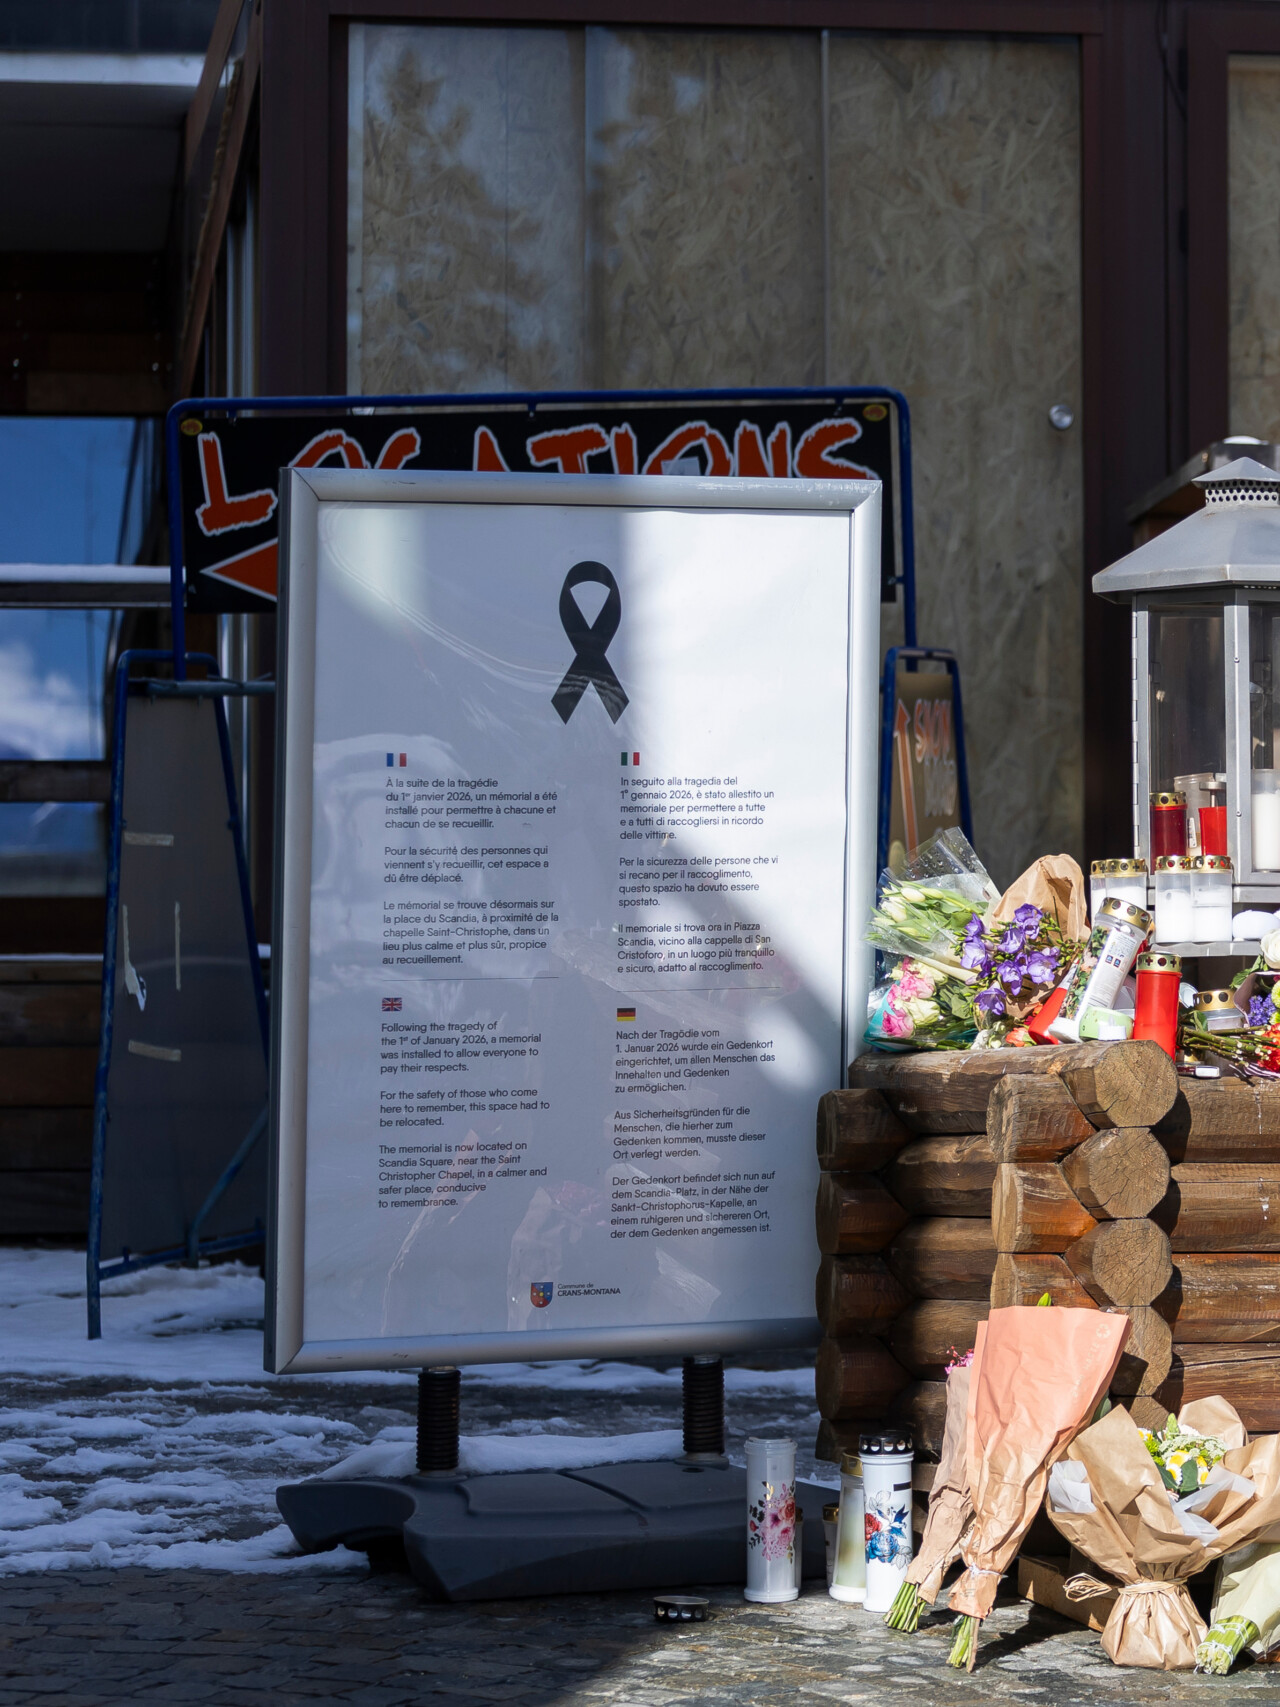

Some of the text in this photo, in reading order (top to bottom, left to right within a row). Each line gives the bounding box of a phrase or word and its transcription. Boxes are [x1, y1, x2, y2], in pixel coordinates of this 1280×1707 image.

[385, 777, 498, 789] À la suite de la tragédie
[620, 777, 737, 788] In seguito alla tragedia del
[412, 792, 444, 803] janvier
[446, 792, 473, 802] 2026,
[489, 792, 532, 800] mémorial
[541, 792, 557, 800] été
[630, 791, 667, 801] gennaio
[669, 791, 694, 800] 2026,
[695, 790, 702, 798] è
[704, 790, 726, 798] stato
[728, 790, 762, 798] allestito
[385, 805, 556, 817] installé pour permettre à chacune et
[620, 804, 667, 812] memoriale
[668, 805, 684, 814] per
[686, 803, 736, 814] permettere
[745, 803, 765, 811] tutte
[384, 820, 420, 828] chacun
[422, 820, 436, 828] de
[451, 820, 494, 828] recueillir.
[635, 818, 653, 826] tutti
[655, 817, 665, 825] di
[667, 817, 719, 828] raccogliersi
[721, 817, 729, 825] in
[731, 817, 763, 825] ricordo
[619, 831, 676, 839] delle vittime.
[384, 846, 548, 857] Pour la sécurité des personnes qui
[383, 860, 425, 868] viennent
[442, 860, 485, 869] recueillir,
[487, 860, 503, 868] cet
[505, 861, 541, 870] espace
[383, 873, 463, 884] dû être déplacé.
[396, 955, 463, 964] recueillement.
[381, 1022, 497, 1034] Following the tragedy of
[615, 1030, 639, 1039] Nach
[641, 1030, 657, 1038] der
[659, 1029, 699, 1040] Tragödie
[380, 1037, 397, 1045] the
[410, 1036, 421, 1045] of
[422, 1036, 460, 1047] January
[461, 1035, 488, 1045] 2026,
[498, 1034, 541, 1043] memorial
[615, 1040, 773, 1052] 1. Januar 2026 wurde ein Gedenkort
[401, 1050, 441, 1058] installed
[443, 1049, 454, 1058] to
[455, 1049, 481, 1057] allow
[482, 1049, 527, 1059] everyone
[528, 1048, 539, 1056] to
[615, 1056, 672, 1068] eingerichtet,
[689, 1055, 710, 1064] allen
[712, 1054, 757, 1063] Menschen
[759, 1053, 775, 1062] das
[380, 1063, 469, 1075] pay their respects.
[615, 1068, 729, 1079] Innehalten und Gedenken
[627, 1083, 686, 1095] ermöglichen.
[380, 1091, 396, 1099] For
[398, 1091, 414, 1099] the
[416, 1090, 445, 1101] safety
[447, 1090, 457, 1098] of
[459, 1089, 486, 1098] those
[488, 1089, 508, 1097] who
[379, 1101, 550, 1113] here to remember, this space had to
[613, 1107, 750, 1121] Aus Sicherheitsgründen für die
[379, 1117, 444, 1126] be relocated.
[613, 1123, 662, 1133] Menschen,
[664, 1122, 680, 1131] die
[681, 1121, 713, 1130] hierher
[613, 1132, 766, 1145] Gedenken kommen, musste dieser
[612, 1149, 700, 1161] Ort verlegt werden.
[378, 1183, 486, 1196] safer place, conducive
[377, 1198, 458, 1208] to remembrance.
[610, 1199, 744, 1214] Sankt-Christophorus-Kapelle,
[557, 1288, 621, 1297] CRANS-MONTANA
